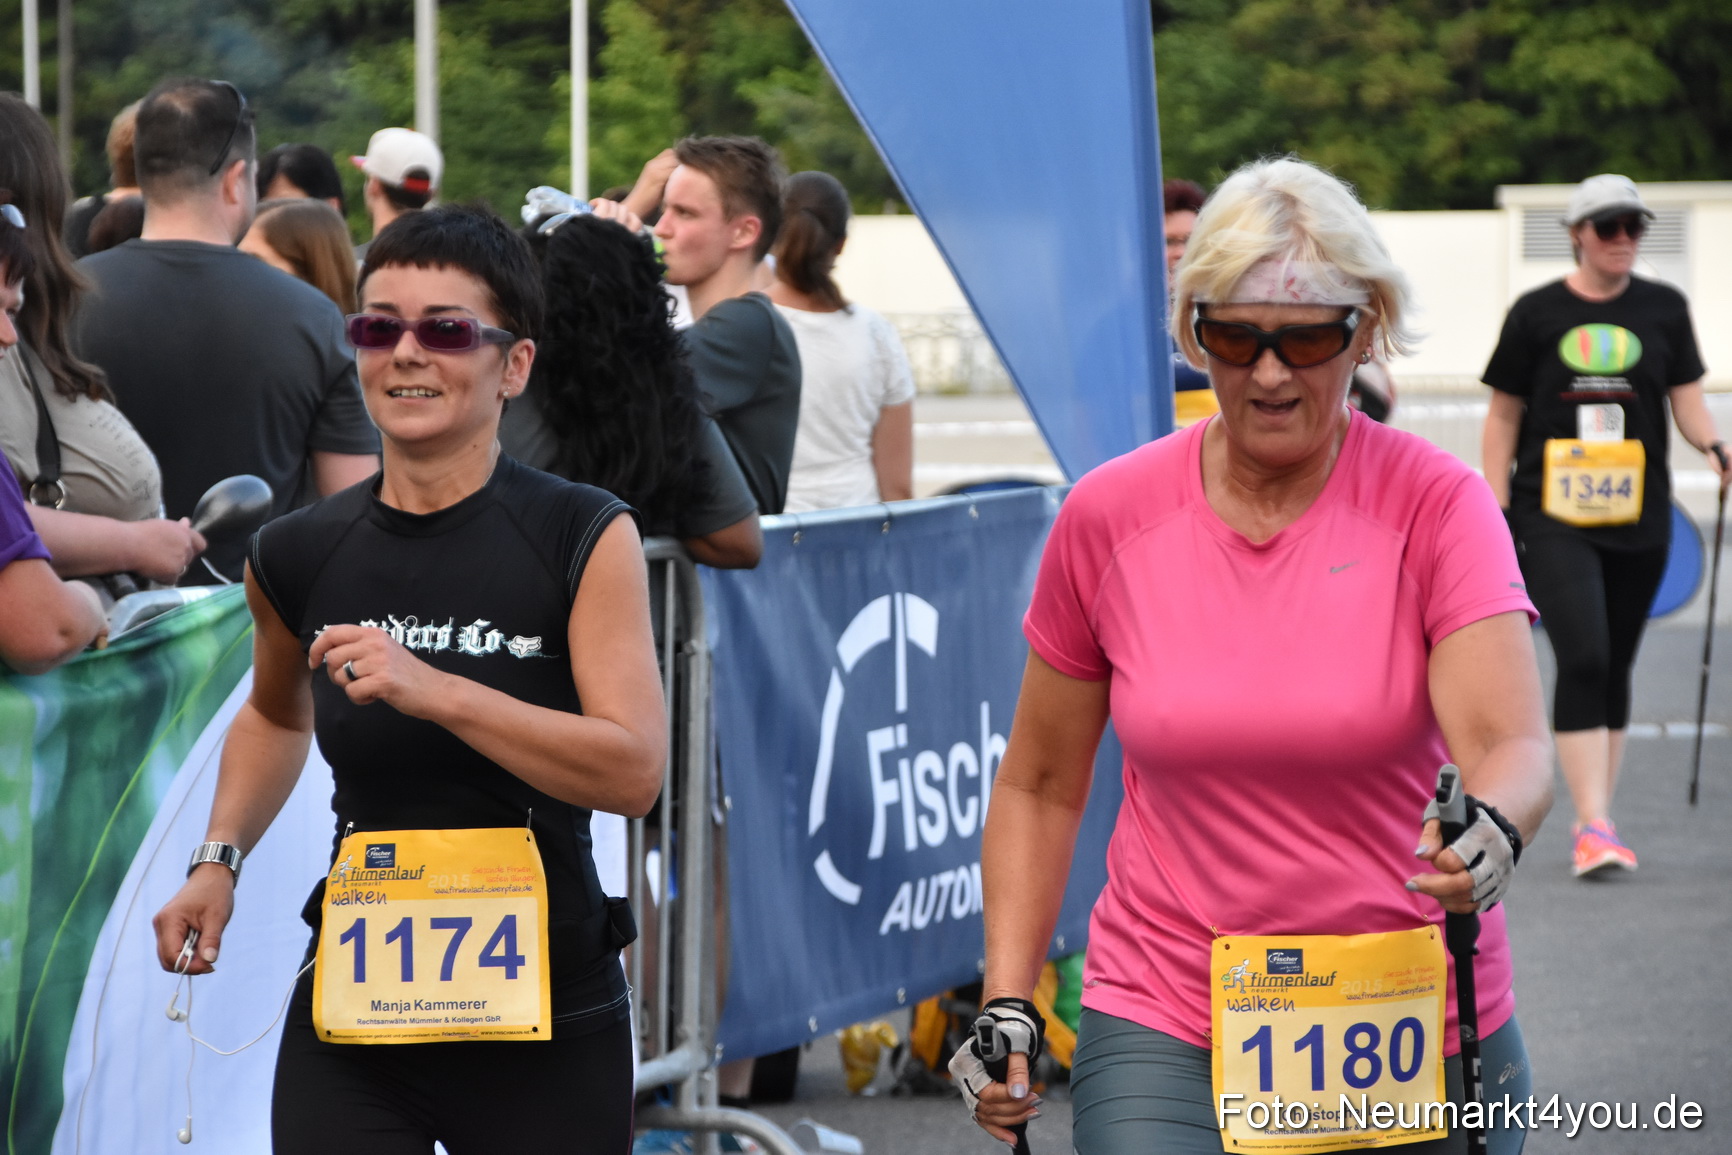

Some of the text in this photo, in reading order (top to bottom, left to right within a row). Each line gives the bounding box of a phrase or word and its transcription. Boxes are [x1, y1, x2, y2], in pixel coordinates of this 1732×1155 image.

[1559, 474, 1632, 500] 1344
[351, 865, 425, 881] firmenlauf
[427, 874, 471, 888] 2015
[331, 888, 387, 905] walken
[340, 914, 526, 983] 1174
[1251, 971, 1337, 987] firmenlauf
[1340, 979, 1383, 995] 2015
[371, 1000, 487, 1014] Manja Kammerer
[1227, 995, 1295, 1013] walken
[452, 1016, 484, 1025] Kollegen
[1242, 1017, 1425, 1092] 1180
